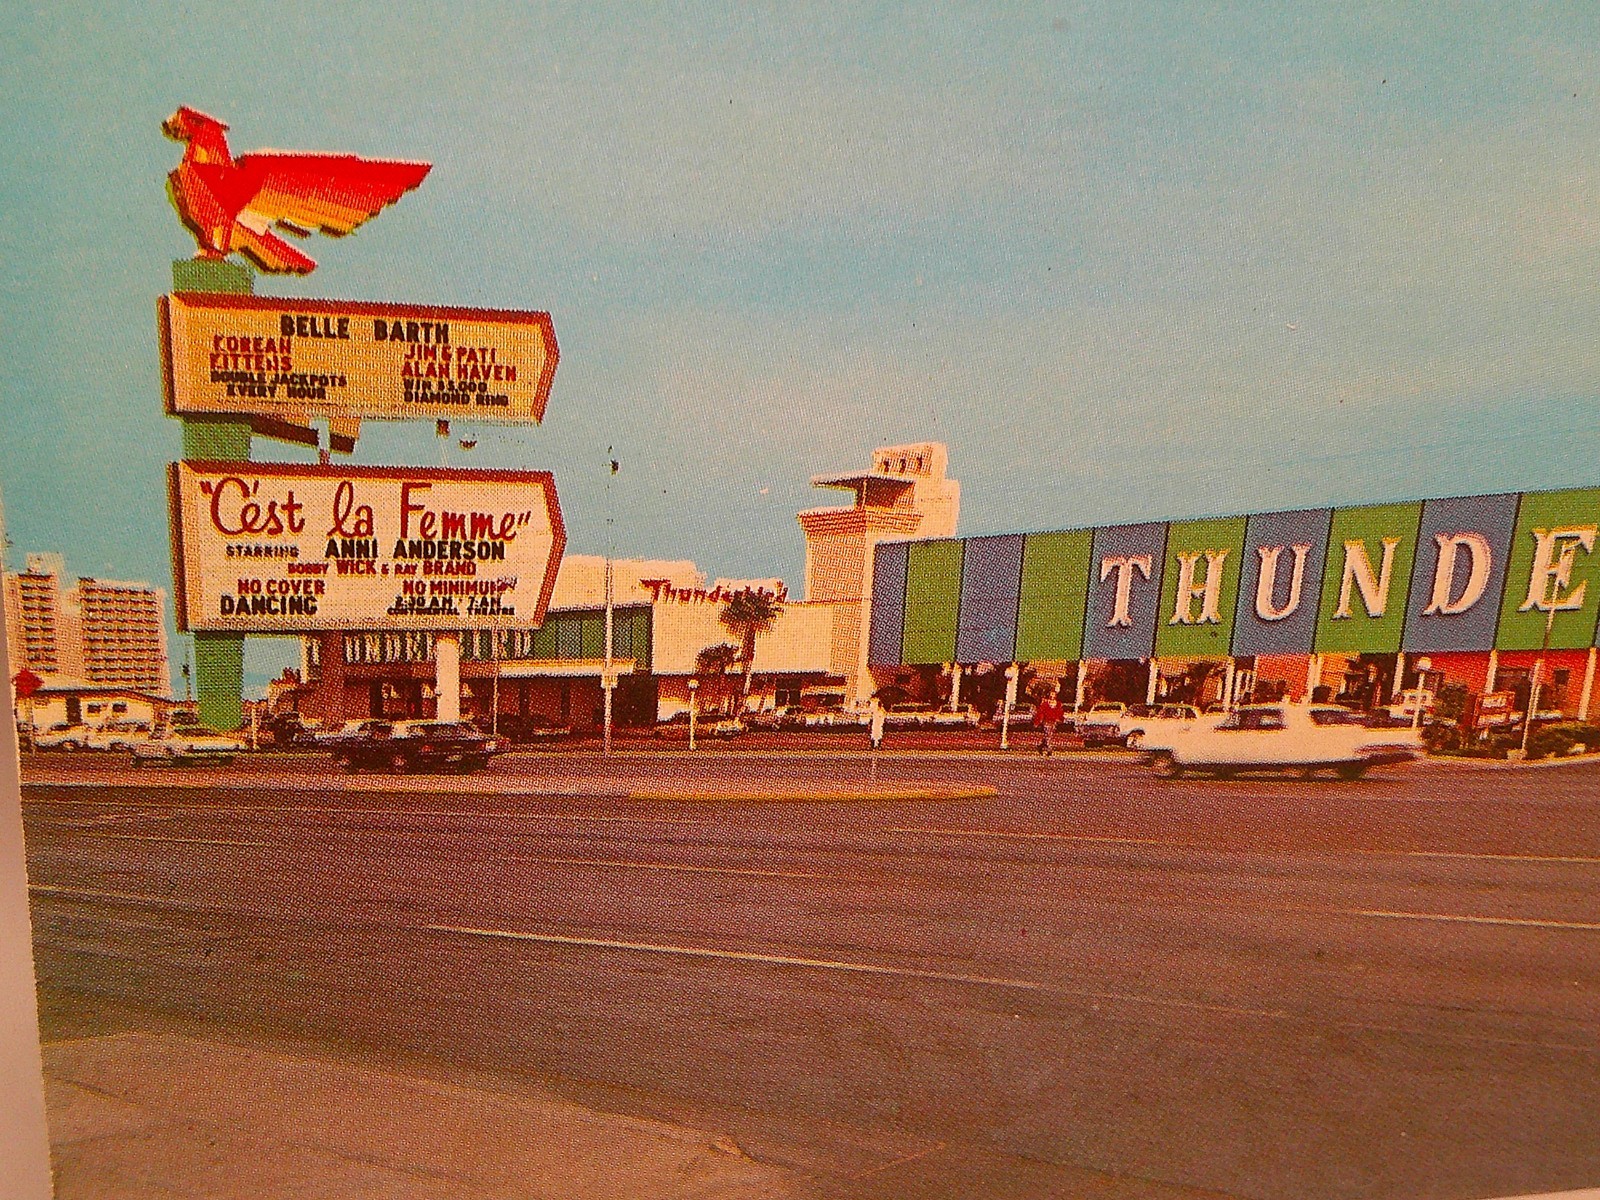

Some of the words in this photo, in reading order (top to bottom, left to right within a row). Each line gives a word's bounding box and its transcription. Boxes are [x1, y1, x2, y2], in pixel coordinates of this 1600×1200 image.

[281, 314, 349, 339] BELLE
[374, 319, 449, 343] BARTH
[213, 334, 291, 354] KOREAN
[210, 353, 293, 371] KITTENS
[401, 361, 450, 378] ALAN
[457, 363, 517, 381] HAVEN
[227, 384, 276, 397] EVERY
[287, 386, 326, 398] HOUR
[404, 379, 431, 390] WIN
[404, 391, 470, 404] DIAMOND
[327, 480, 373, 537] la
[226, 544, 299, 557] STARRING
[325, 538, 378, 558] ANNI
[393, 540, 504, 559] ANDERSON
[336, 560, 377, 574] WICK
[395, 563, 417, 575] RAY
[423, 561, 476, 575] BRAND
[1101, 524, 1597, 628] THUNDE
[237, 579, 261, 594] NO
[266, 579, 325, 594] COVER
[402, 580, 426, 594] NO
[221, 595, 317, 615] DANCING
